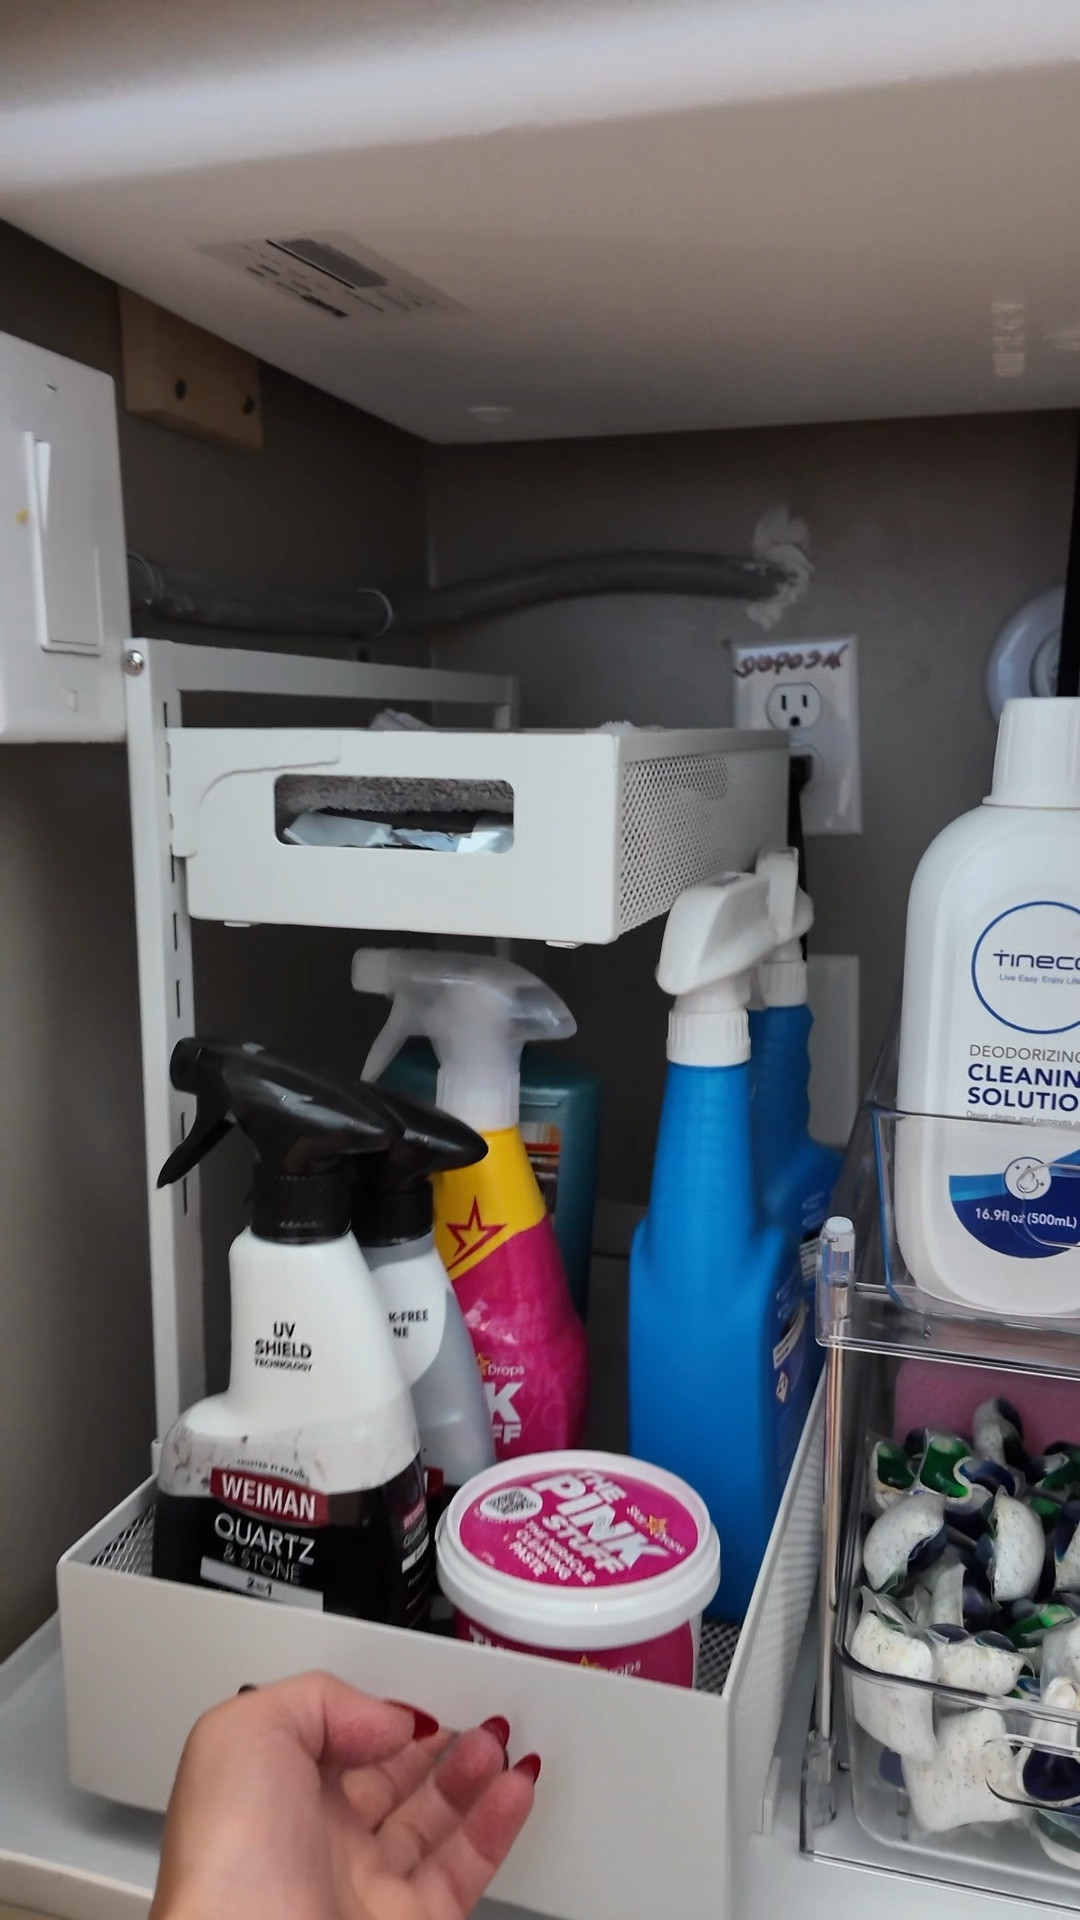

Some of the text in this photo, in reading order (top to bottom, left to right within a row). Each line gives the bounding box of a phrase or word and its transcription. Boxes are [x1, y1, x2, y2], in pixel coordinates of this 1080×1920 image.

[1027, 1211, 1078, 1229] (500mL)
[254, 1339, 313, 1360] SHIELD
[273, 1321, 296, 1338] UV
[488, 1363, 526, 1377] Drops
[220, 1472, 317, 1522] WEIMAN
[213, 1511, 316, 1566] QUARTZ
[530, 1474, 671, 1571] PINK
[222, 1543, 301, 1585] & STONE
[508, 1540, 549, 1577] PASTE
[515, 1529, 573, 1581] CLEANING
[541, 1513, 626, 1575] STUFF
